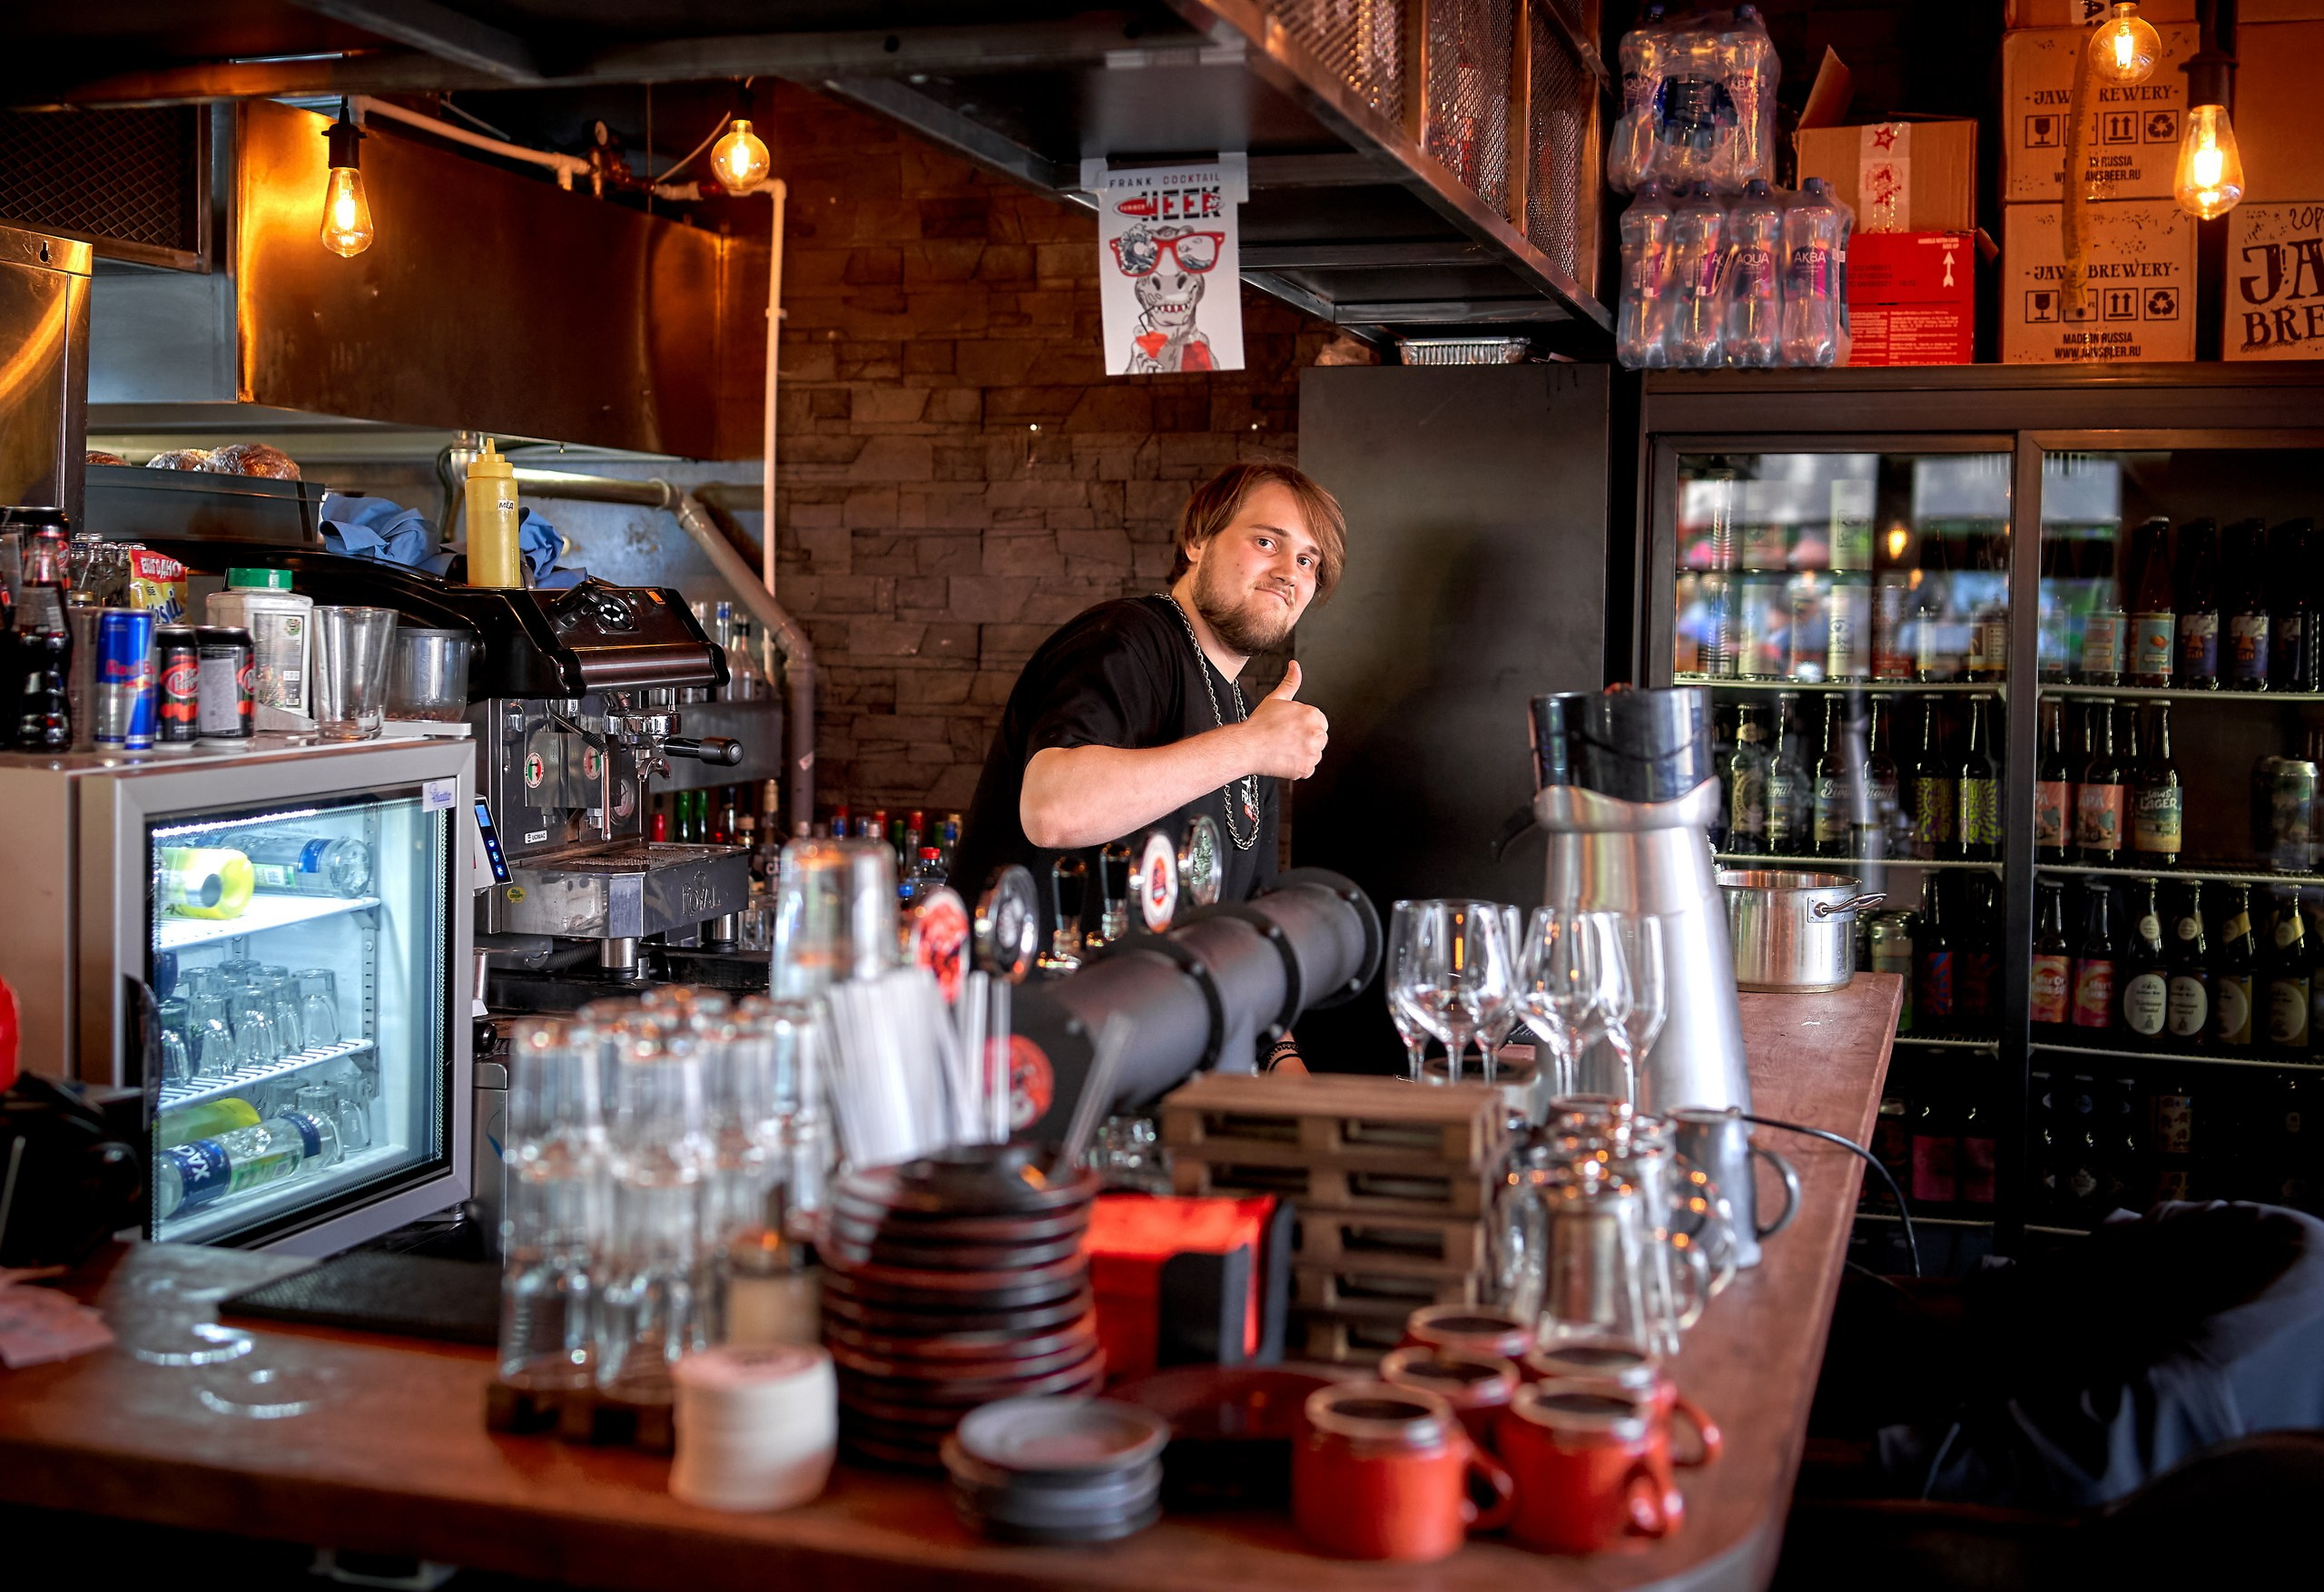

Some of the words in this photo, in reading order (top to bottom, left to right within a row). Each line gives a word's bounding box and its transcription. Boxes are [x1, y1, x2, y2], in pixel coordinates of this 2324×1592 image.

[2034, 90, 2073, 104] JAW
[2099, 85, 2172, 102] REWERY
[2101, 155, 2132, 167] RUSSIA
[1109, 177, 1152, 188] FRANK
[1163, 173, 1220, 185] COCKTAIL
[1737, 252, 1769, 267] AQUA
[1794, 251, 1827, 264] АКВА
[2088, 261, 2172, 279] BREWERY
[2063, 334, 2089, 344] MADE
[2101, 332, 2132, 343] RUSSIA
[106, 659, 140, 676] Red
[2145, 789, 2172, 801] JAWS
[2140, 797, 2178, 810] LAGER
